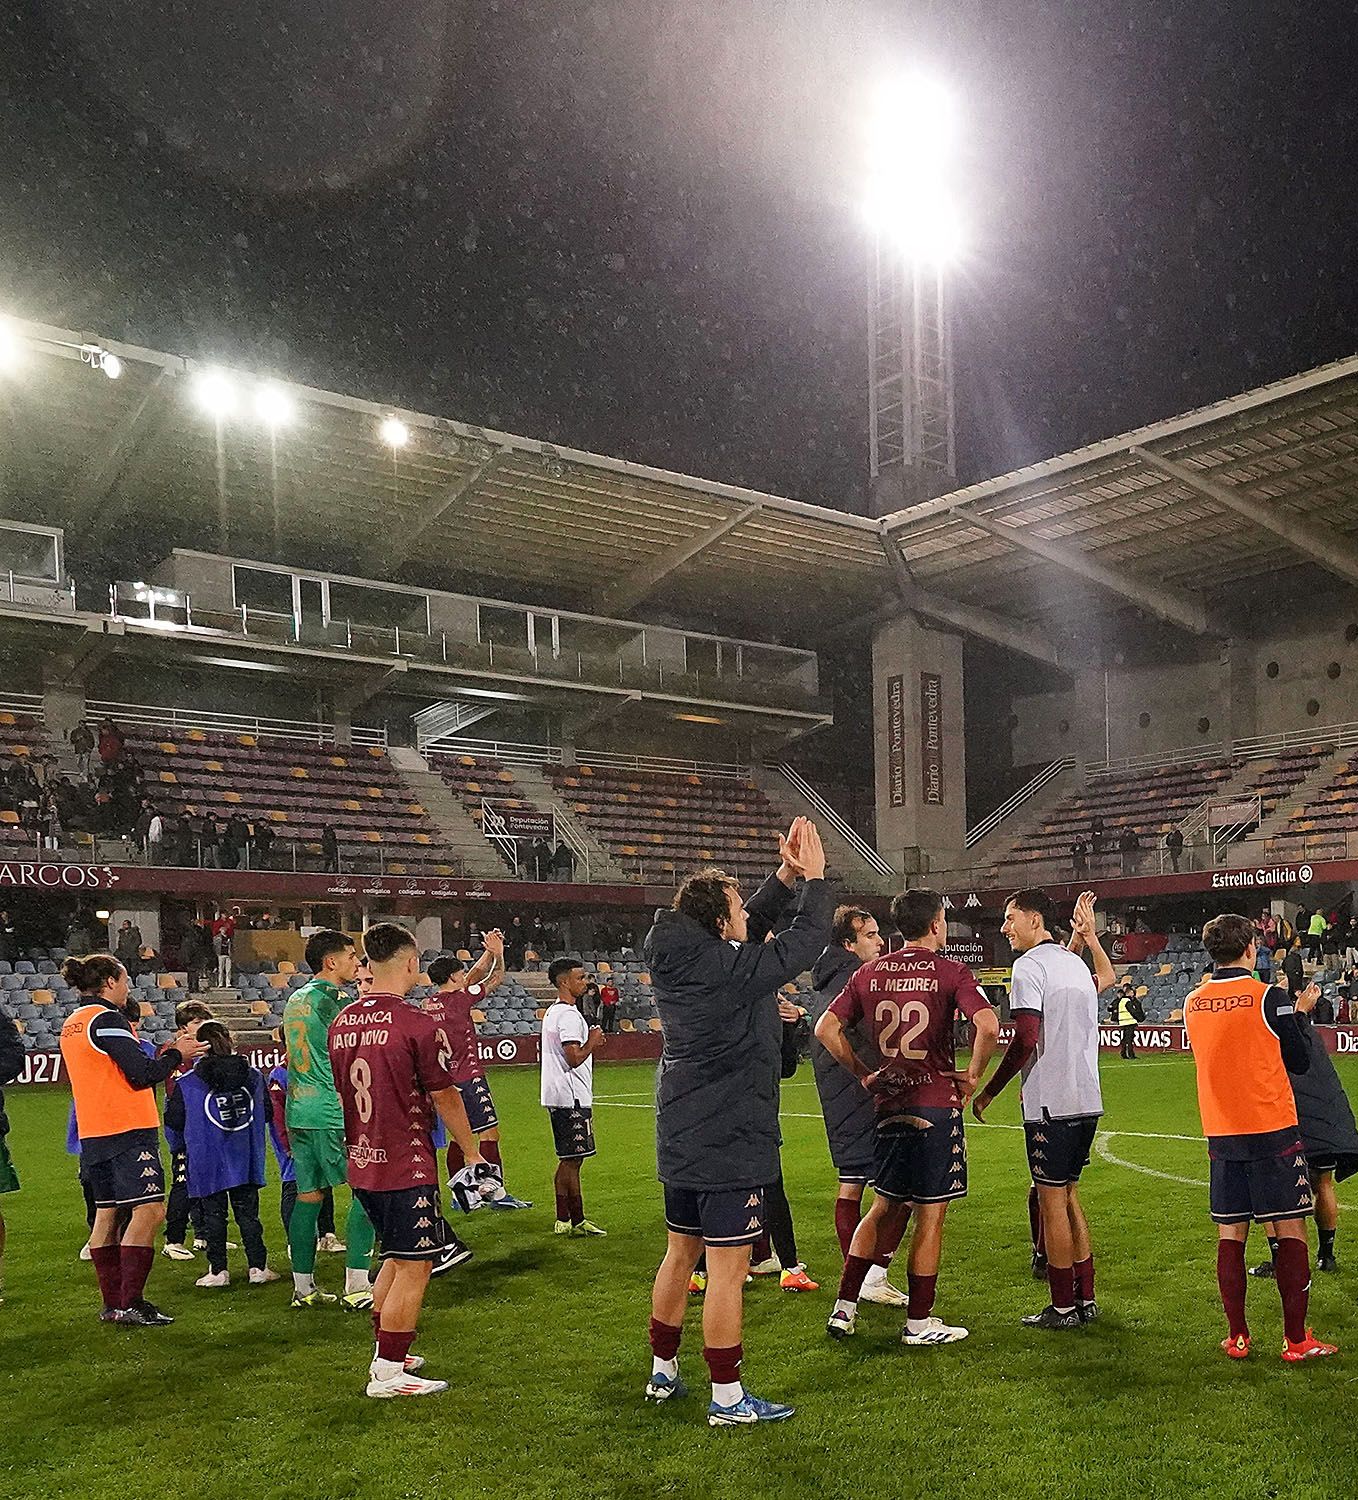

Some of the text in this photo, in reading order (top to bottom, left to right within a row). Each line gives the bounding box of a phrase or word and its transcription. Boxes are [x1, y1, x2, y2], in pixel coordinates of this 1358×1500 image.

[890, 681, 902, 754] Pontevedra
[925, 680, 940, 751] Pontevedra
[892, 766, 903, 804] Diario
[927, 764, 940, 802] Diario
[509, 816, 549, 825] Deputación
[510, 822, 549, 831] Pontevedra
[1211, 867, 1297, 888] Estrella Galicia
[875, 961, 936, 972] ABANCA
[870, 979, 881, 992] R.
[1189, 995, 1253, 1012] Kappa
[335, 1010, 393, 1027] ABANCA
[875, 1000, 930, 1060] 22
[350, 1057, 372, 1124] 8
